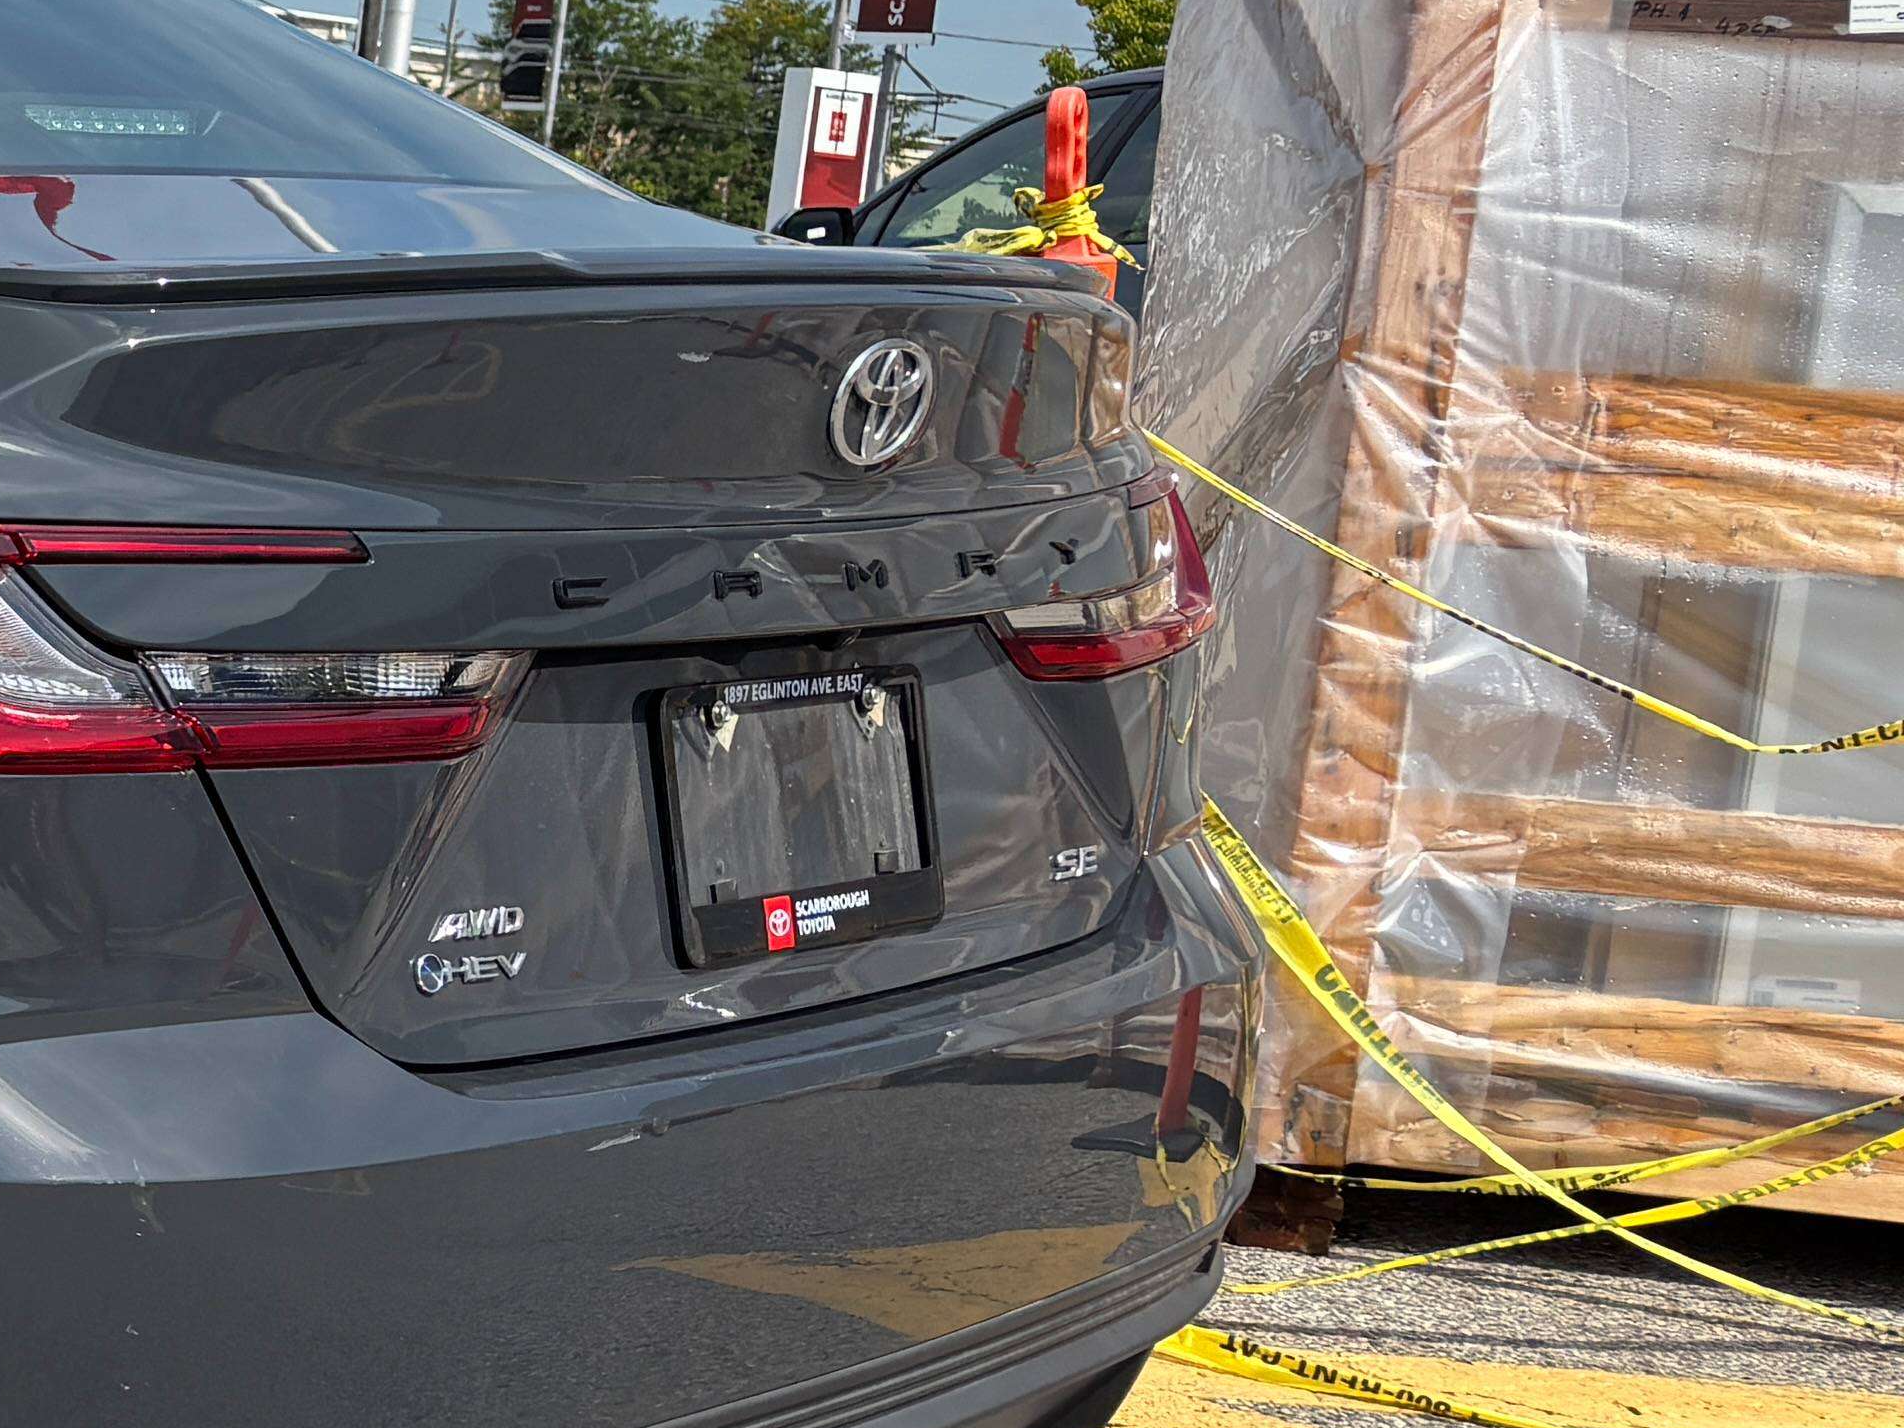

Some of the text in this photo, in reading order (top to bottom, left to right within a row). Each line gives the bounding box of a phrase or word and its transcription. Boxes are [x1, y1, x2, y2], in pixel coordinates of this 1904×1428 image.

[552, 538, 1080, 610] CAMRY
[723, 673, 864, 704] 1897 EGLINTON AVE. EAST
[1049, 844, 1098, 881] SE
[795, 889, 870, 917] SCARBOROUGH
[428, 905, 525, 943] AWD
[797, 915, 836, 936] TOYOTA
